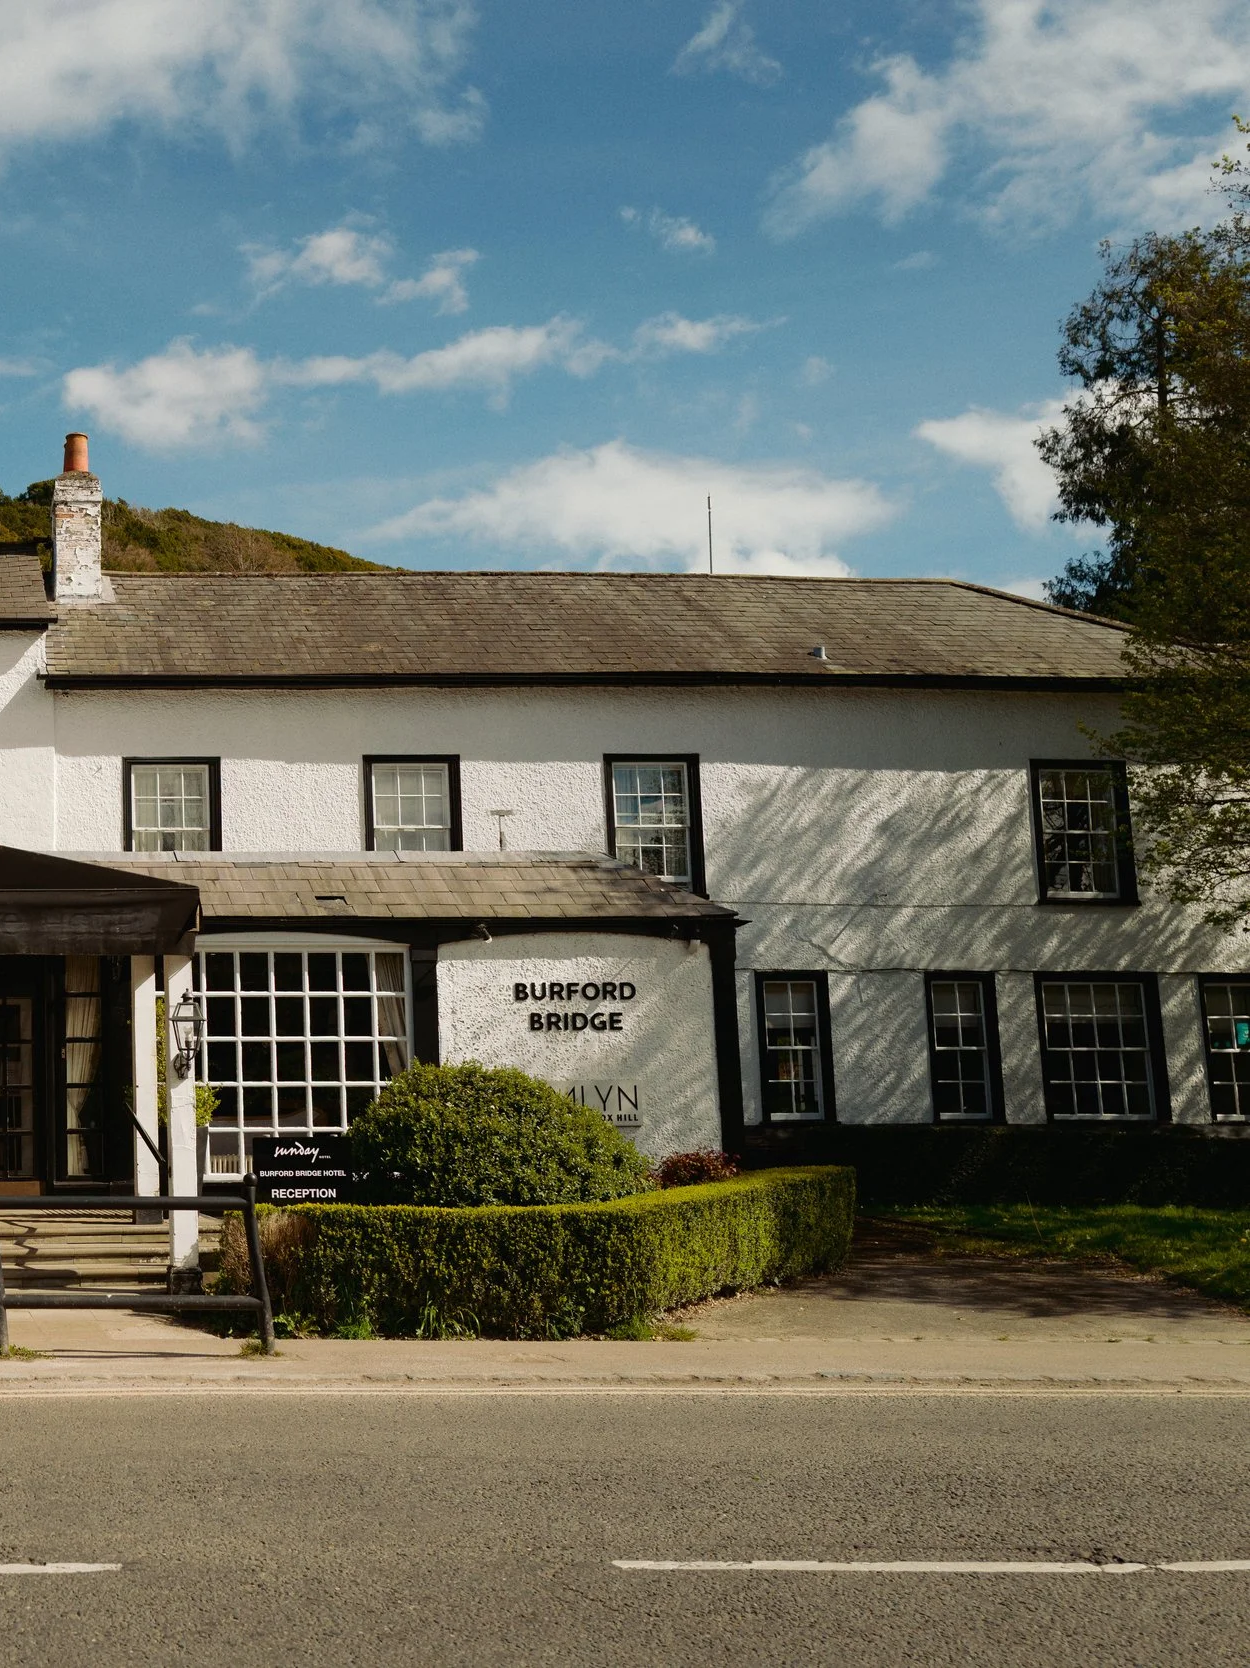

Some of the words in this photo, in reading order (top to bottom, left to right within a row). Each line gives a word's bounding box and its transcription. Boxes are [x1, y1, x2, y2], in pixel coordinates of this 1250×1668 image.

[514, 982, 637, 1001] BURFORD
[529, 1012, 623, 1031] BRIDGE
[617, 1114, 639, 1122] HILL
[274, 1141, 319, 1163] sunday
[271, 1189, 336, 1198] RECEPTION
